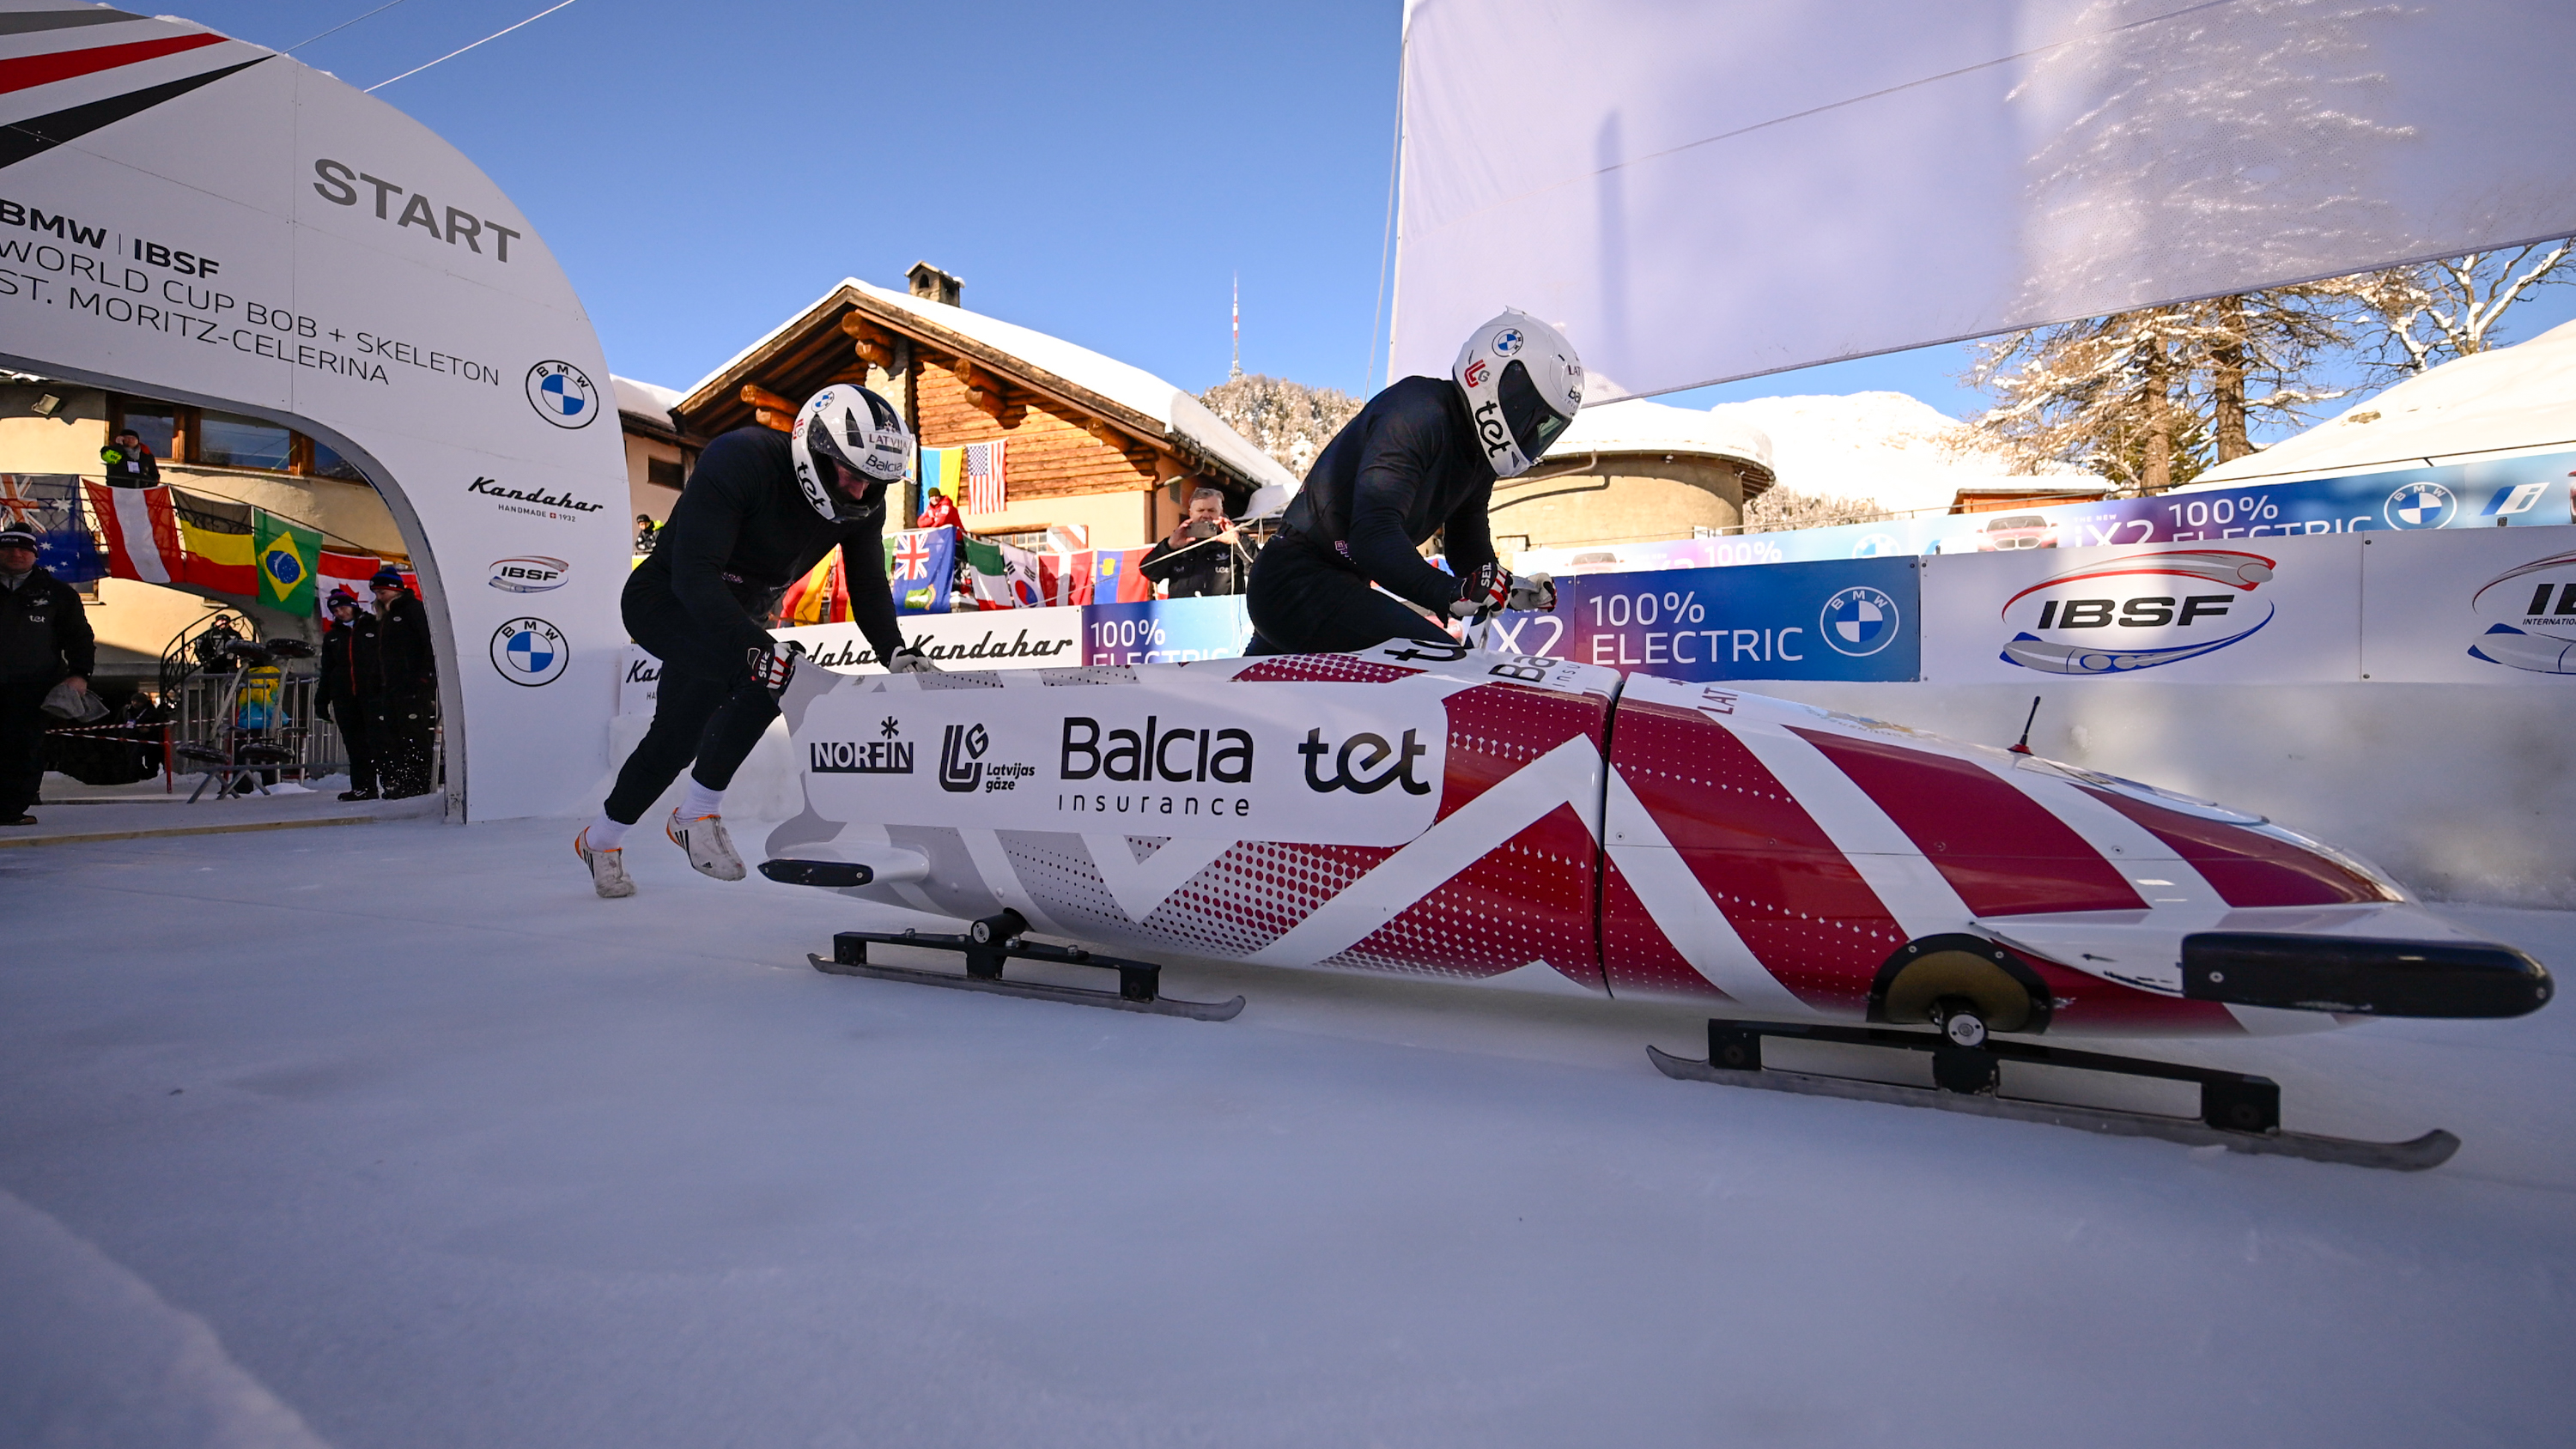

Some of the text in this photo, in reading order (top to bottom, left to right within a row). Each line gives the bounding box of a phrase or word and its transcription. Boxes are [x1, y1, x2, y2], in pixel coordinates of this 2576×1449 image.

[313, 159, 520, 263] START
[0, 198, 219, 278] BMW IBSF
[0, 240, 149, 293] WORLD
[163, 280, 234, 314] CUP
[247, 302, 318, 339] BOB
[356, 331, 499, 386] SKELETON
[0, 269, 389, 385] ST. MORITZ-CELERINA
[536, 363, 589, 389] BMW
[1475, 400, 1512, 458] tet
[866, 454, 902, 472] Balcia
[468, 476, 604, 513] Kandahar
[797, 461, 825, 510] tet
[2393, 484, 2446, 502] BMW
[498, 504, 547, 518] HANDMADE
[2168, 494, 2279, 530] 100%
[1704, 540, 1783, 567] 100%
[501, 567, 559, 581] IBSF
[1589, 591, 1706, 627] 100%
[1832, 590, 1888, 610] BMW
[2037, 594, 2235, 629] IBSF
[501, 621, 559, 640] BMW
[912, 628, 1073, 661] Kandahar
[1090, 618, 1166, 648] 100%
[1593, 627, 1803, 665] ELECTRIC
[811, 742, 914, 774] NORFIN
[1061, 715, 1254, 784] Balcia
[1297, 727, 1432, 796] tet
[985, 777, 1016, 793] gāze
[987, 763, 1036, 779] Latvijas
[1059, 794, 1250, 818] insurance
